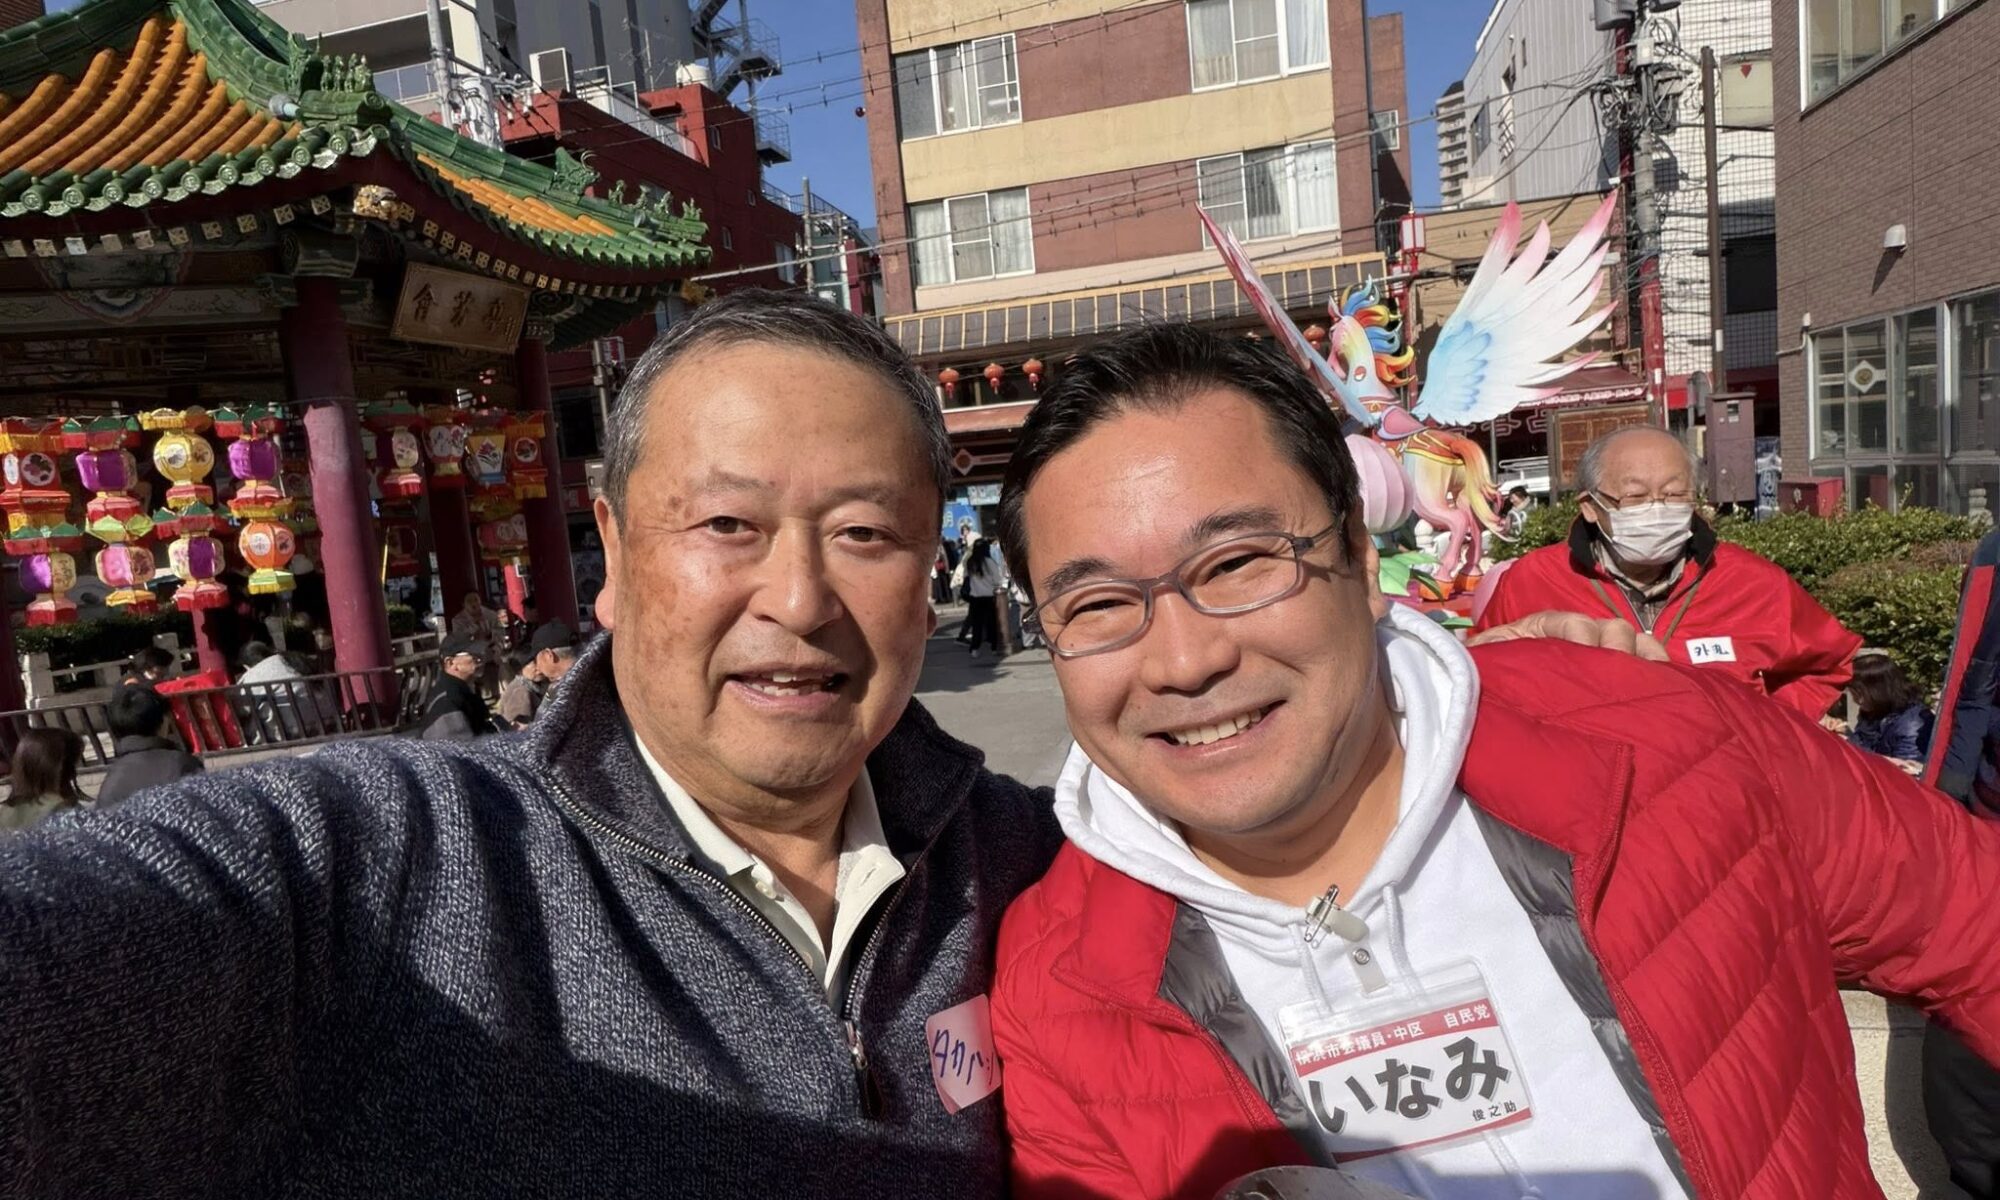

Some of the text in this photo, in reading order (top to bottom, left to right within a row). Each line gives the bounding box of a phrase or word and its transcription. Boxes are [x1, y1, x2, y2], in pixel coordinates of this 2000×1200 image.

[1443, 1004, 1491, 1028] 自民党
[1308, 1036, 1512, 1135] いなみ
[1472, 1101, 1518, 1122] 俊之助
